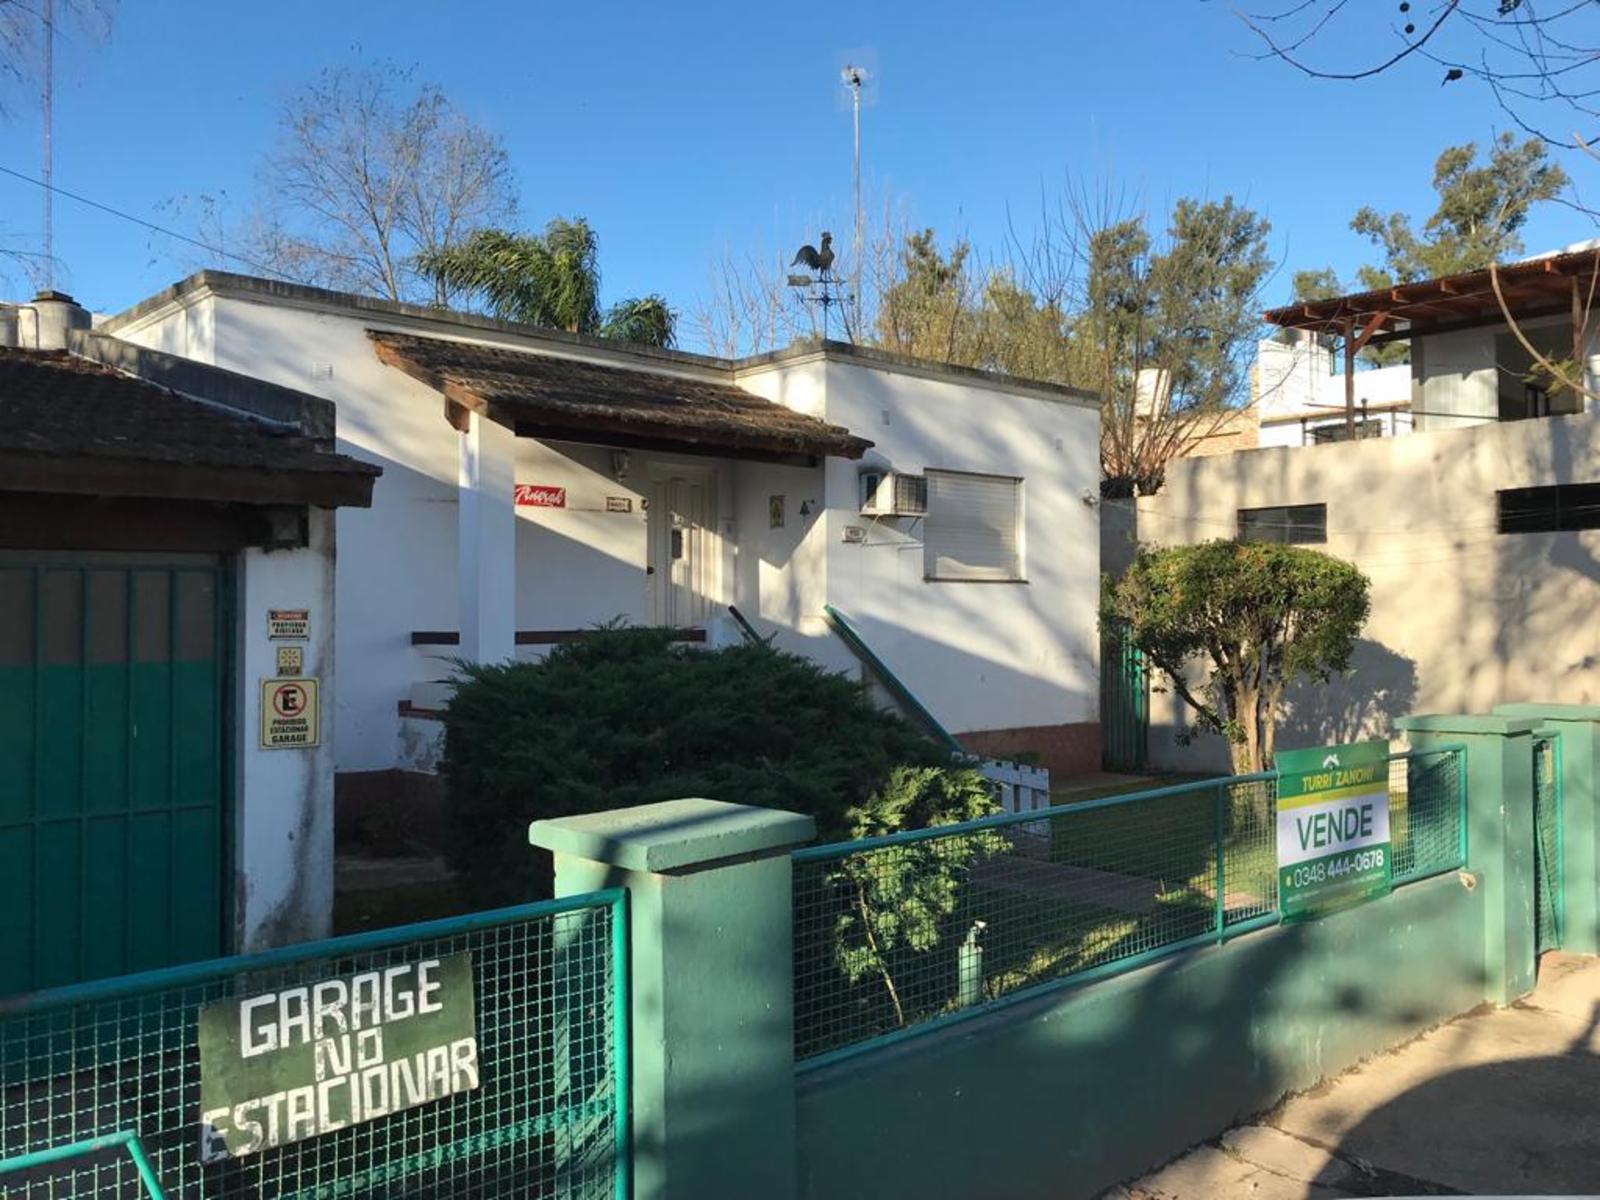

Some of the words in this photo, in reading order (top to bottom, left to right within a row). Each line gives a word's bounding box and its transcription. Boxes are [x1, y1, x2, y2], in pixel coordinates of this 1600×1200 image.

[282, 688, 298, 711] E
[270, 724, 309, 735] ESTACIONAR
[271, 734, 307, 744] GARAGE
[272, 718, 307, 726] PROHIBIDO
[1296, 804, 1374, 851] VENDE
[1294, 862, 1326, 888] 0348
[1327, 849, 1384, 877] 444-0678
[239, 959, 444, 1059] GARAGE
[313, 1025, 385, 1082] NO
[201, 1036, 480, 1163] ESTACIONAR
